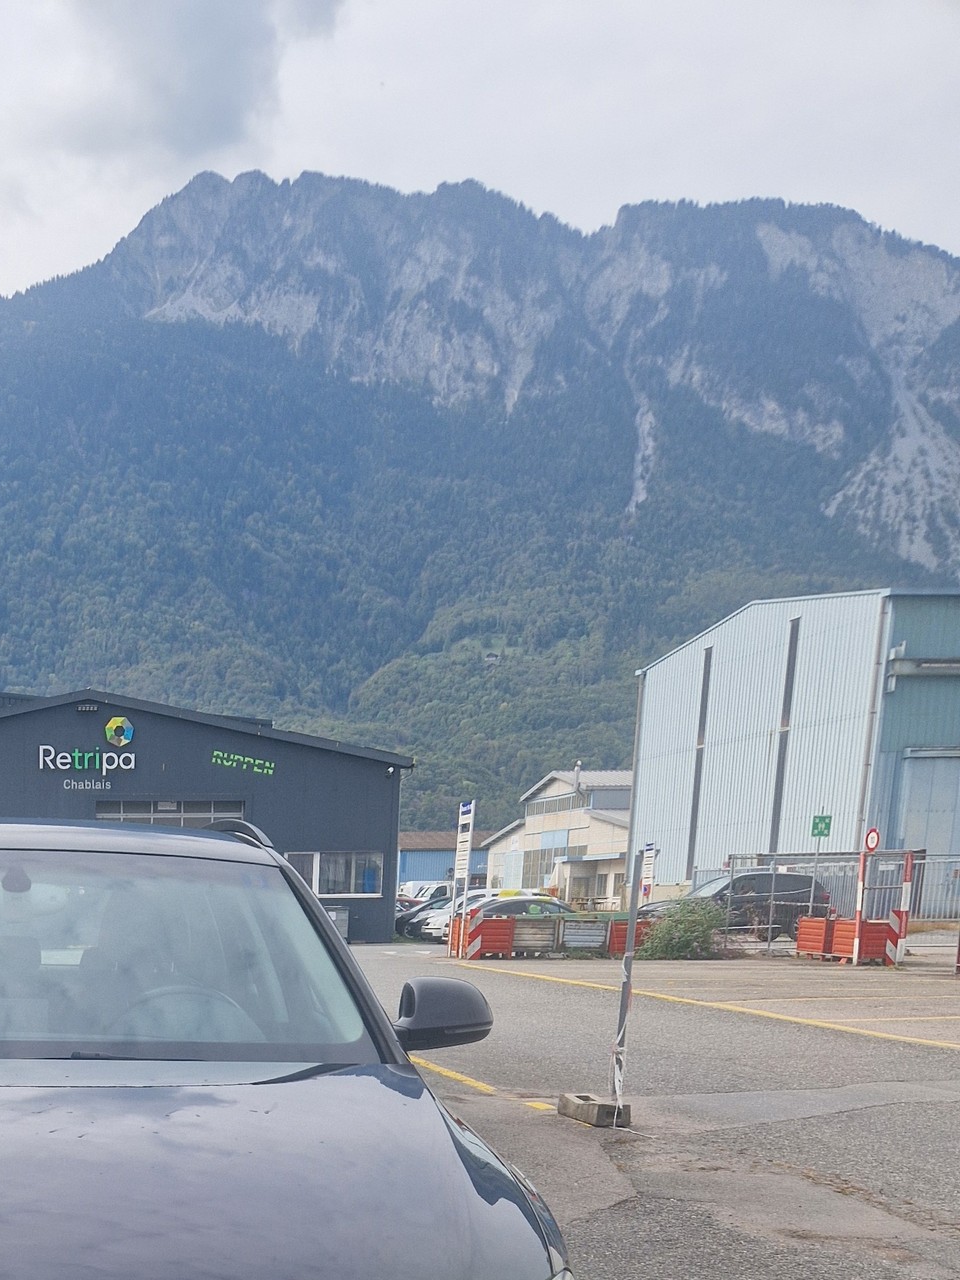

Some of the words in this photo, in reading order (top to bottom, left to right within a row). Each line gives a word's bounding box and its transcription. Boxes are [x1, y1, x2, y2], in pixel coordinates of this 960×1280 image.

[39, 745, 136, 776] Retripa
[211, 750, 275, 775] RUPPEN
[63, 779, 112, 790] Chablais
